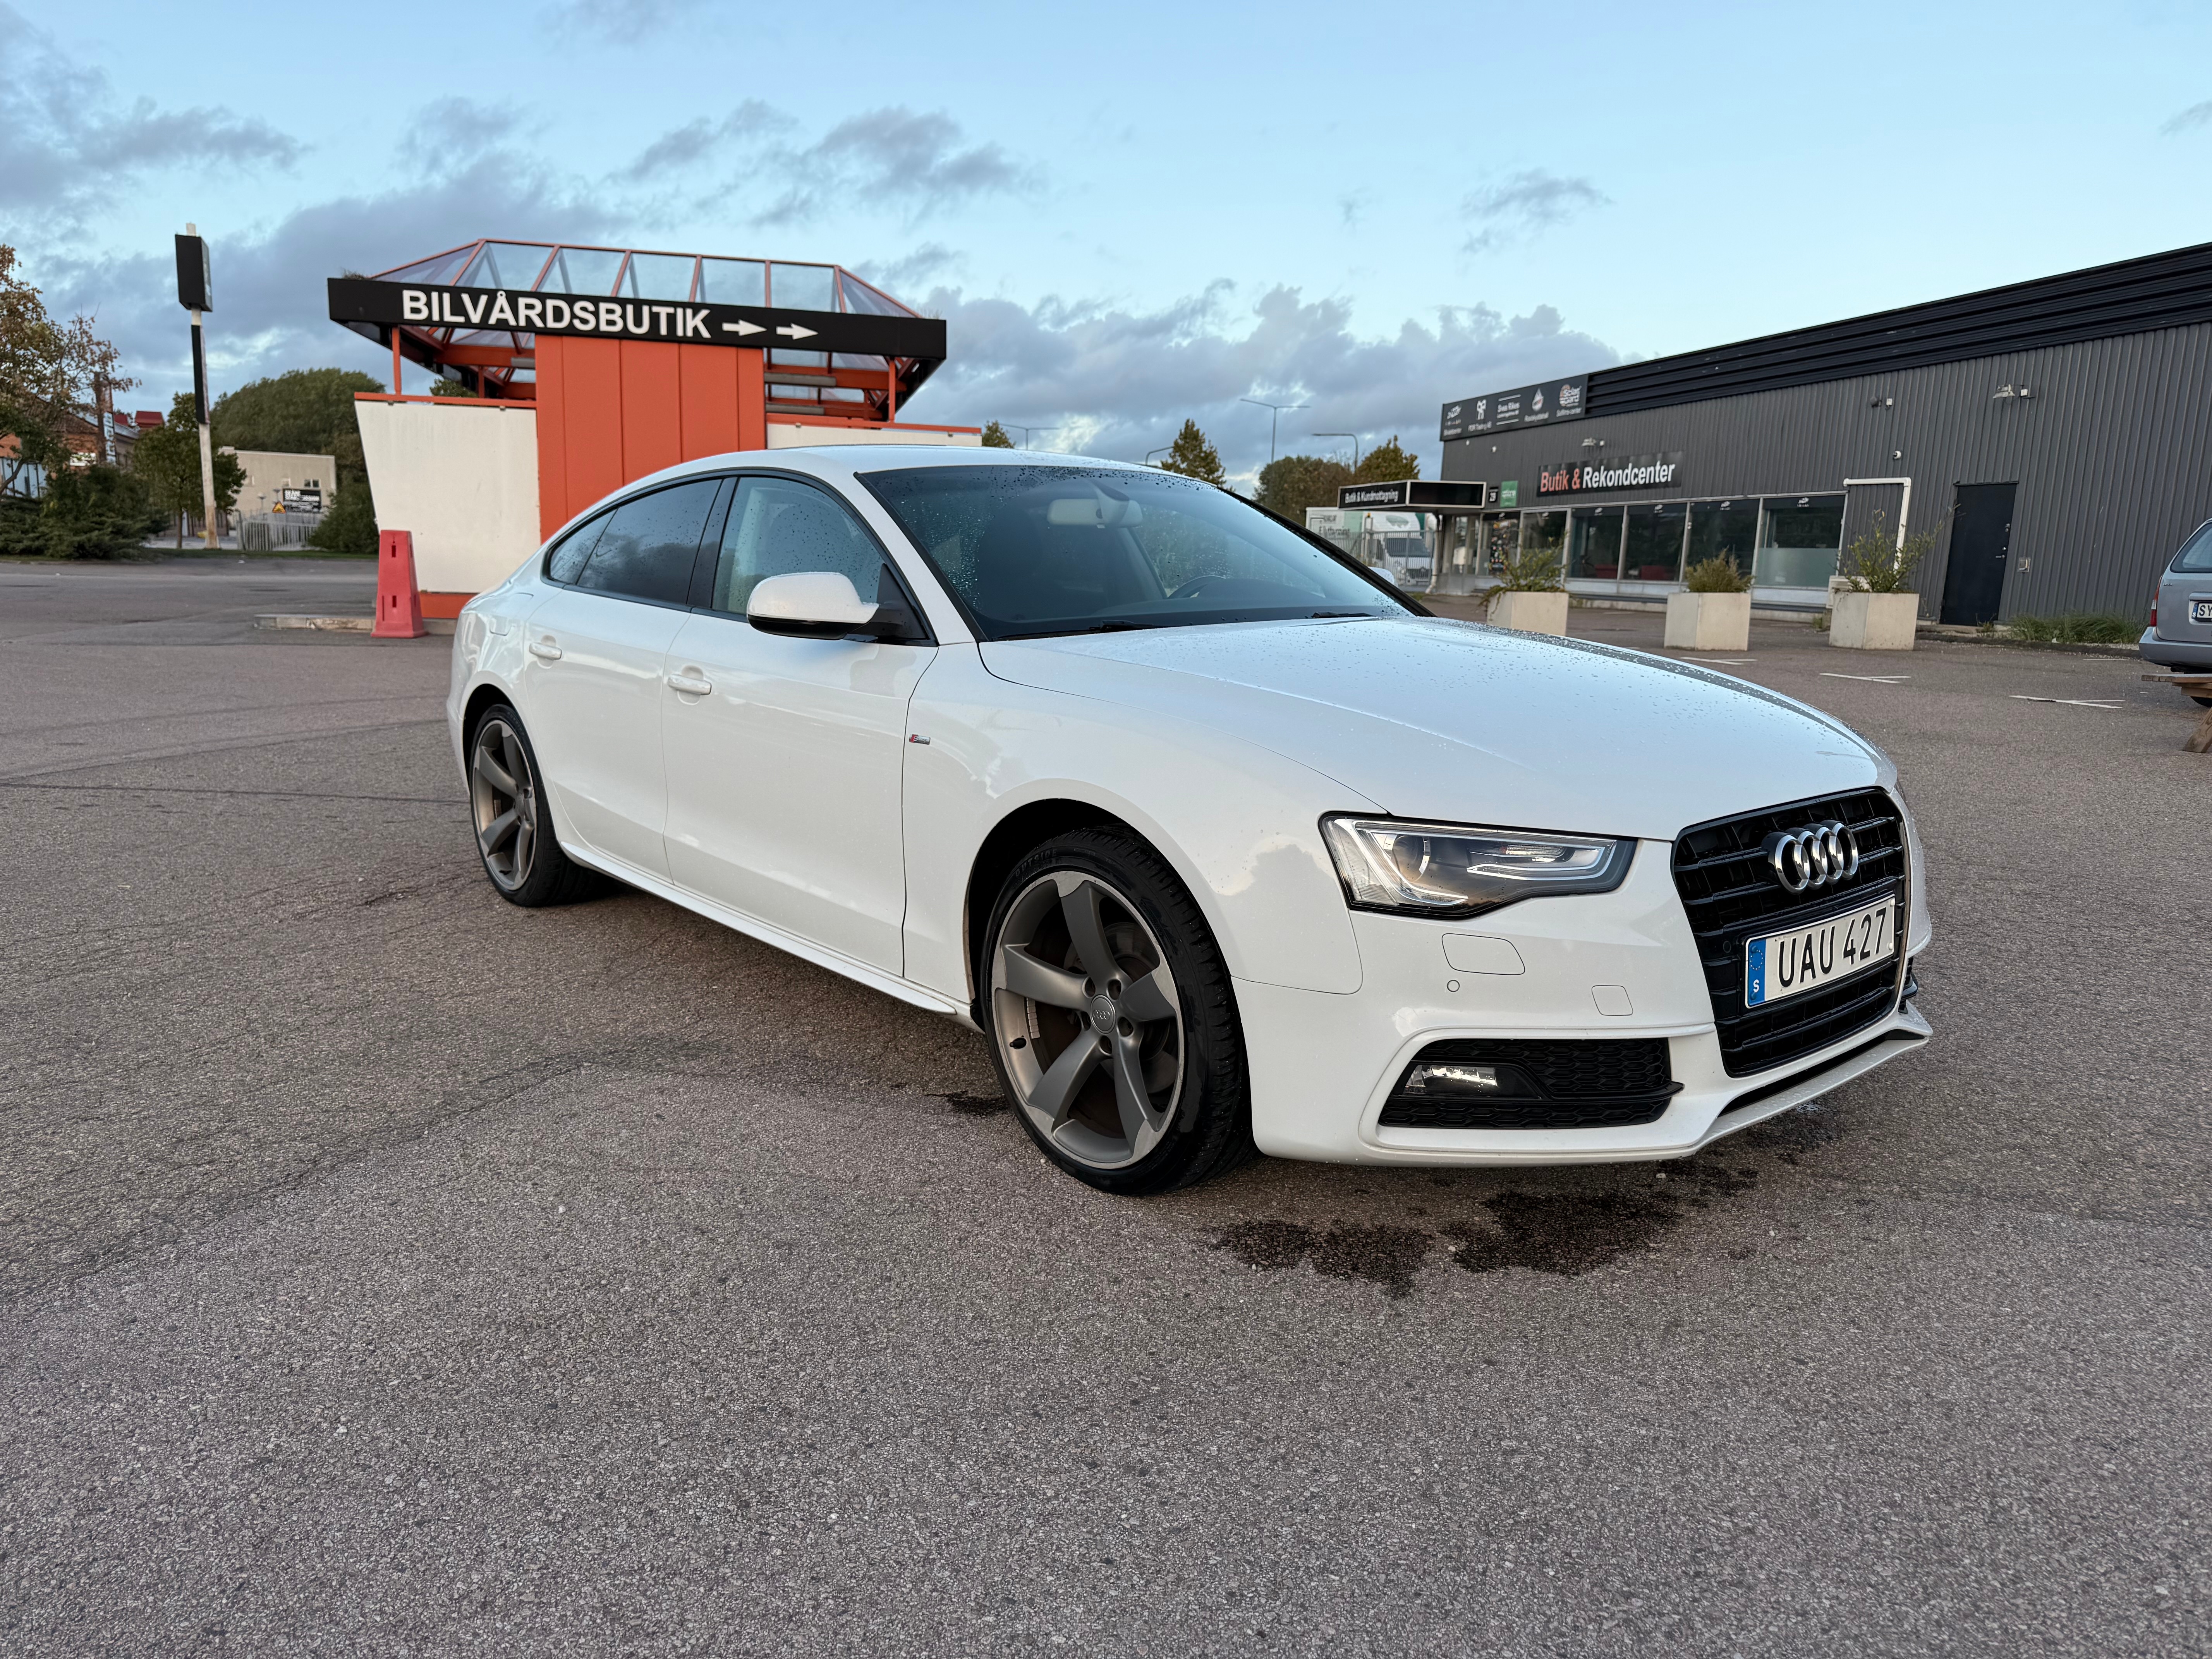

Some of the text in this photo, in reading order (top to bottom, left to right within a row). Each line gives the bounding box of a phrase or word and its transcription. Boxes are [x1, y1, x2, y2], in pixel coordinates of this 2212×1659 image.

[402, 289, 712, 338] BILVÅRDSBUTIK
[1540, 460, 1675, 493] Butik & Rekondcenter
[1345, 489, 1399, 503] Butik & Kundmottagning
[1015, 848, 1058, 877] OUTSIDE
[1779, 907, 1887, 988] UAU 427
[1753, 979, 1760, 993] S
